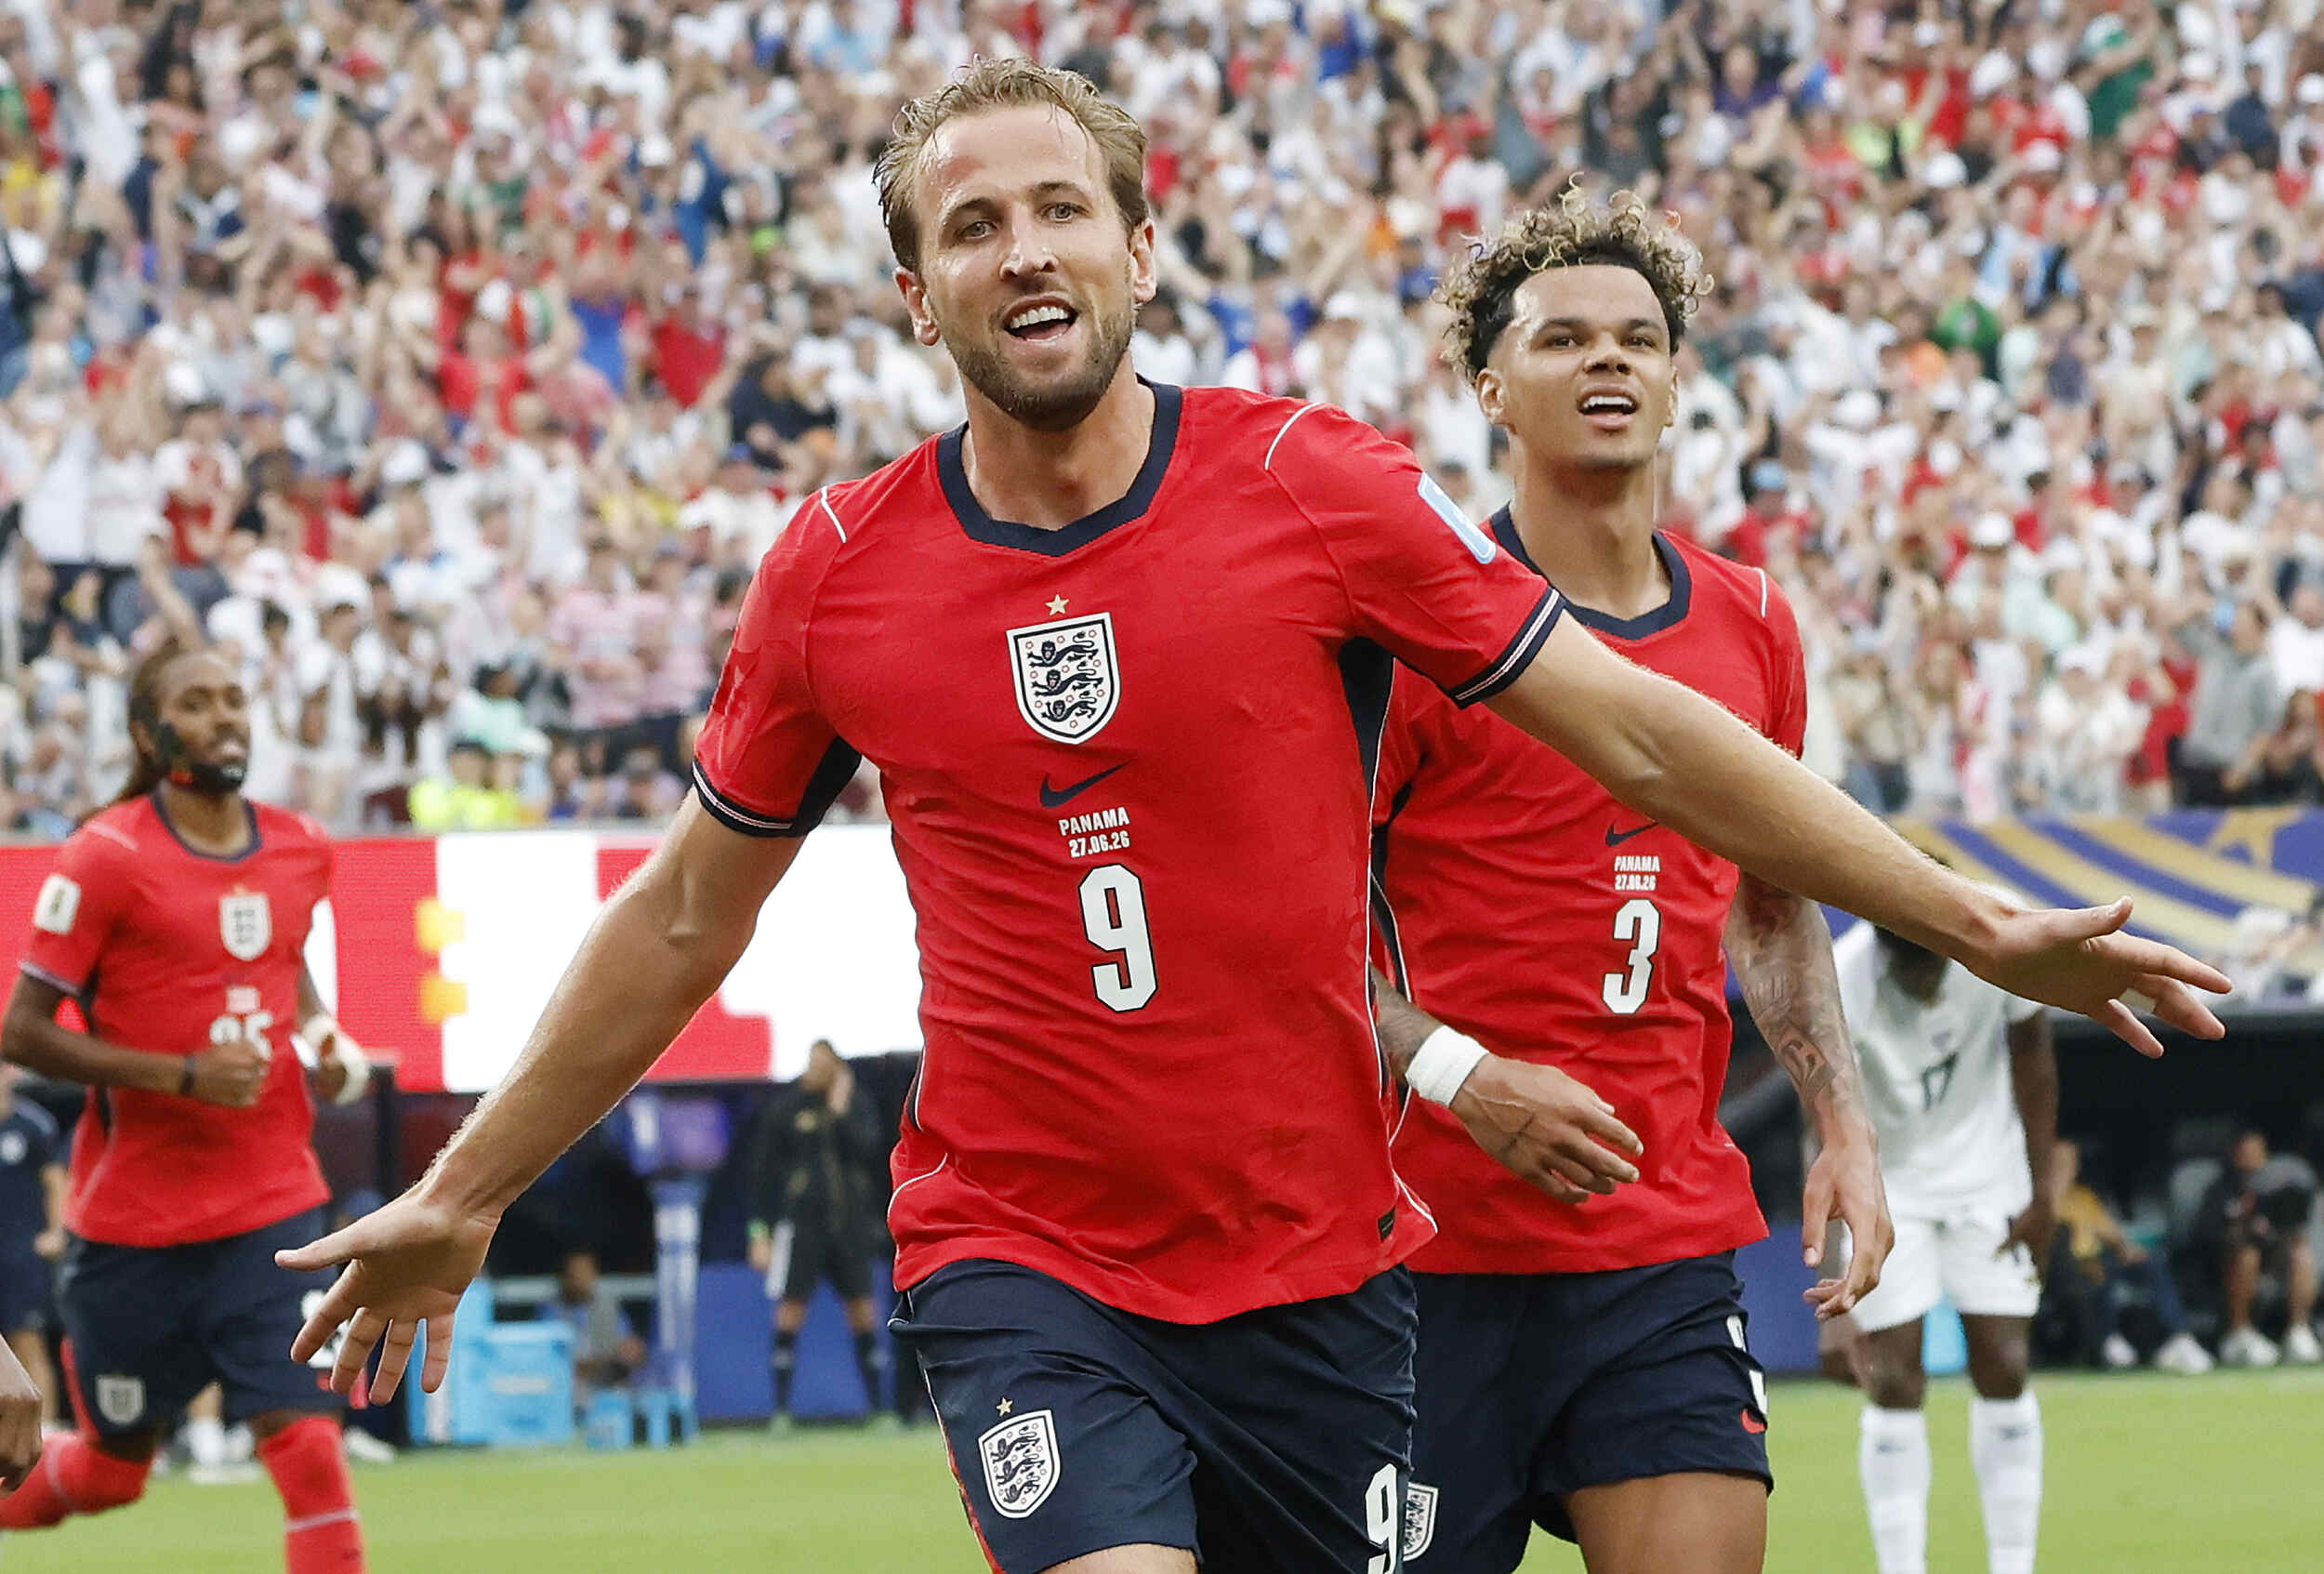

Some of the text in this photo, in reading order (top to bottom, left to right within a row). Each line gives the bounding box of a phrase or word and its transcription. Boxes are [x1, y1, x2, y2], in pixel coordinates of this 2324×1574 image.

[1058, 806, 1130, 836] PANAMA
[1068, 830, 1130, 858] 27.06.26
[1614, 855, 1661, 873] PANAMA
[1078, 863, 1158, 1012] 9
[1602, 898, 1661, 1015] 3
[1364, 1462, 1398, 1574] 9
